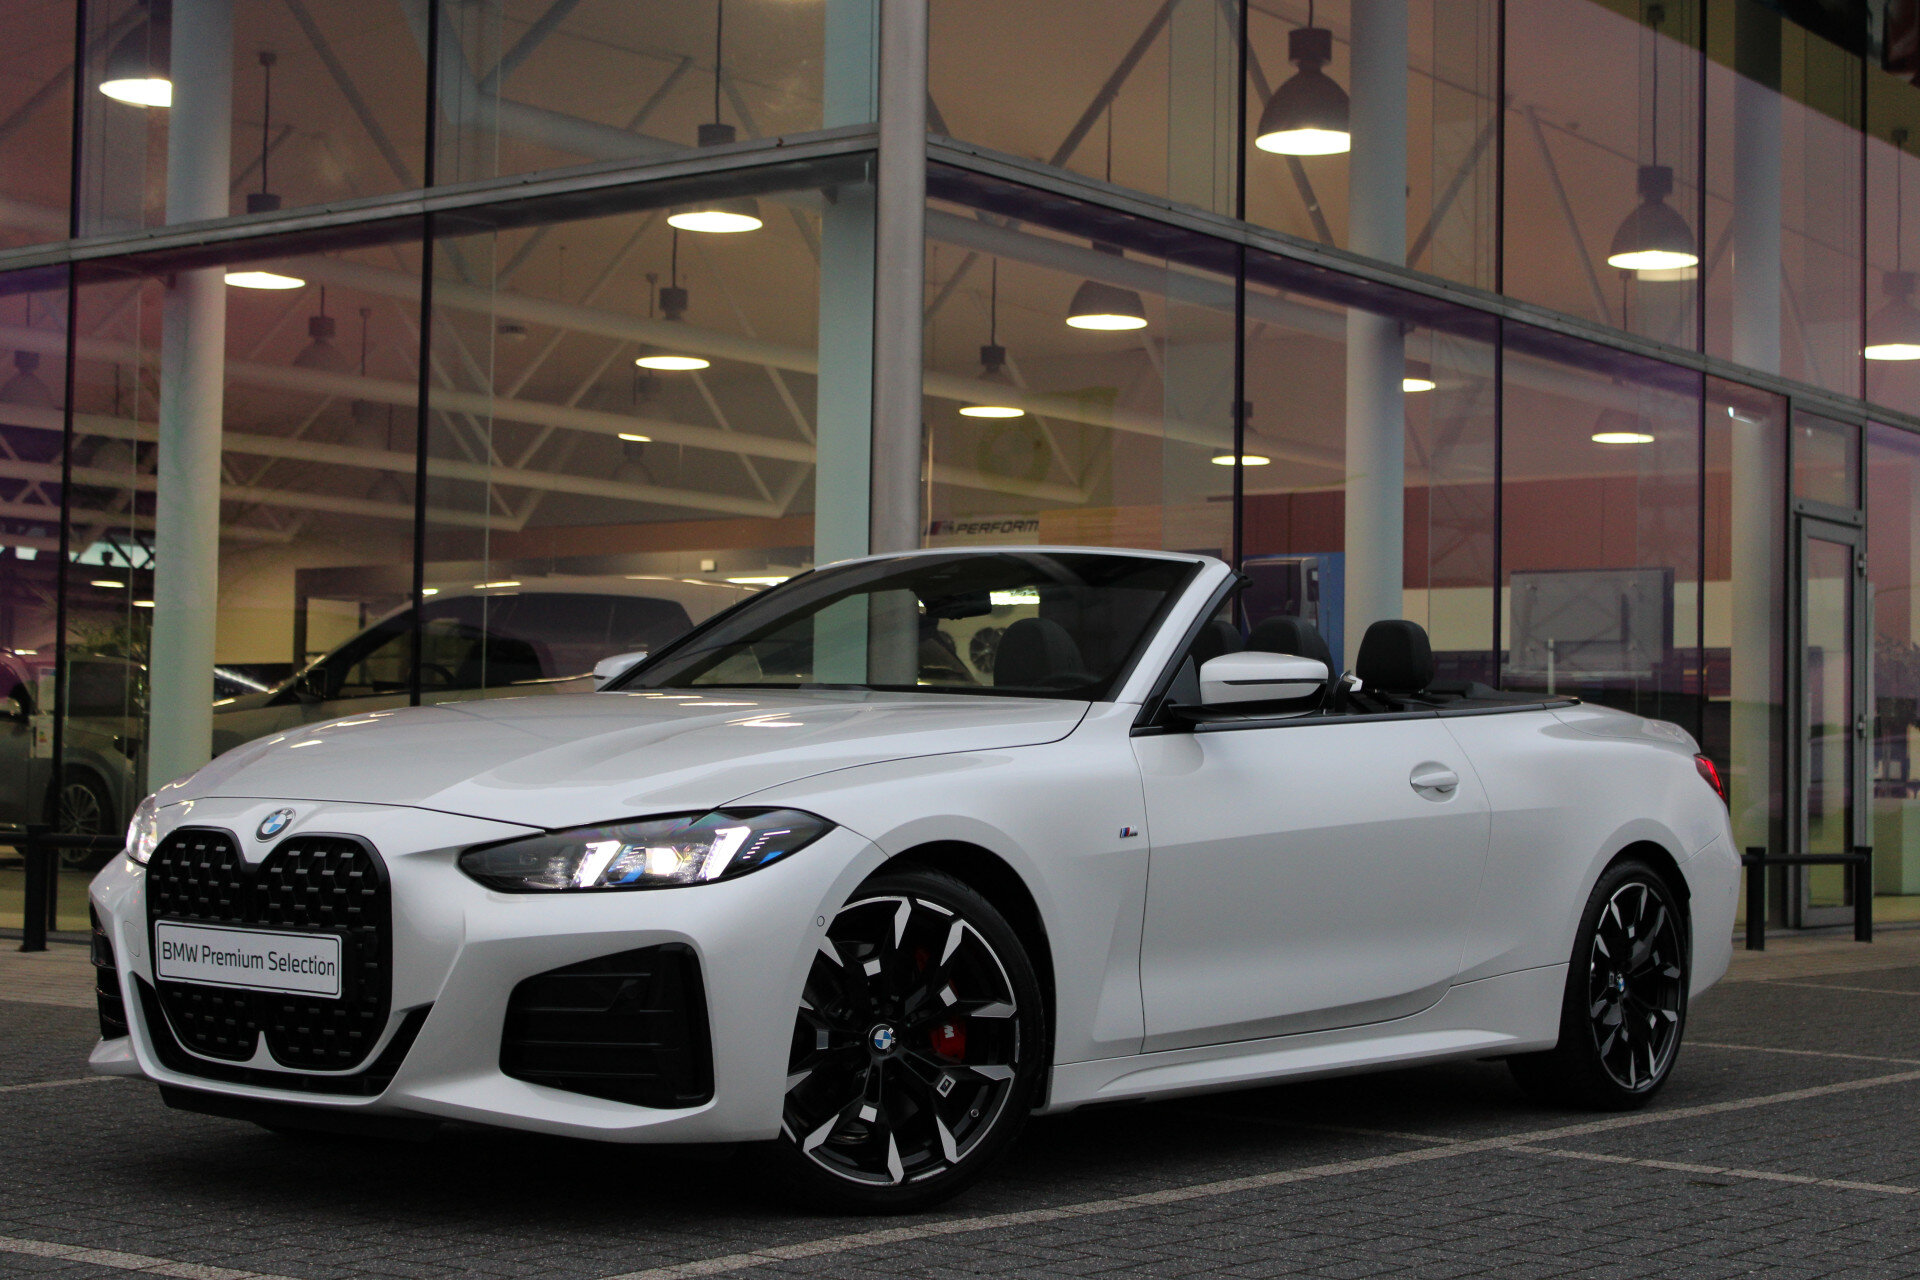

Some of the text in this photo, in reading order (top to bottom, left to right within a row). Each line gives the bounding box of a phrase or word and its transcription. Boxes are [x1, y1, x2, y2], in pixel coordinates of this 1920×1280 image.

[162, 941, 335, 976] BMW Premium Selection
